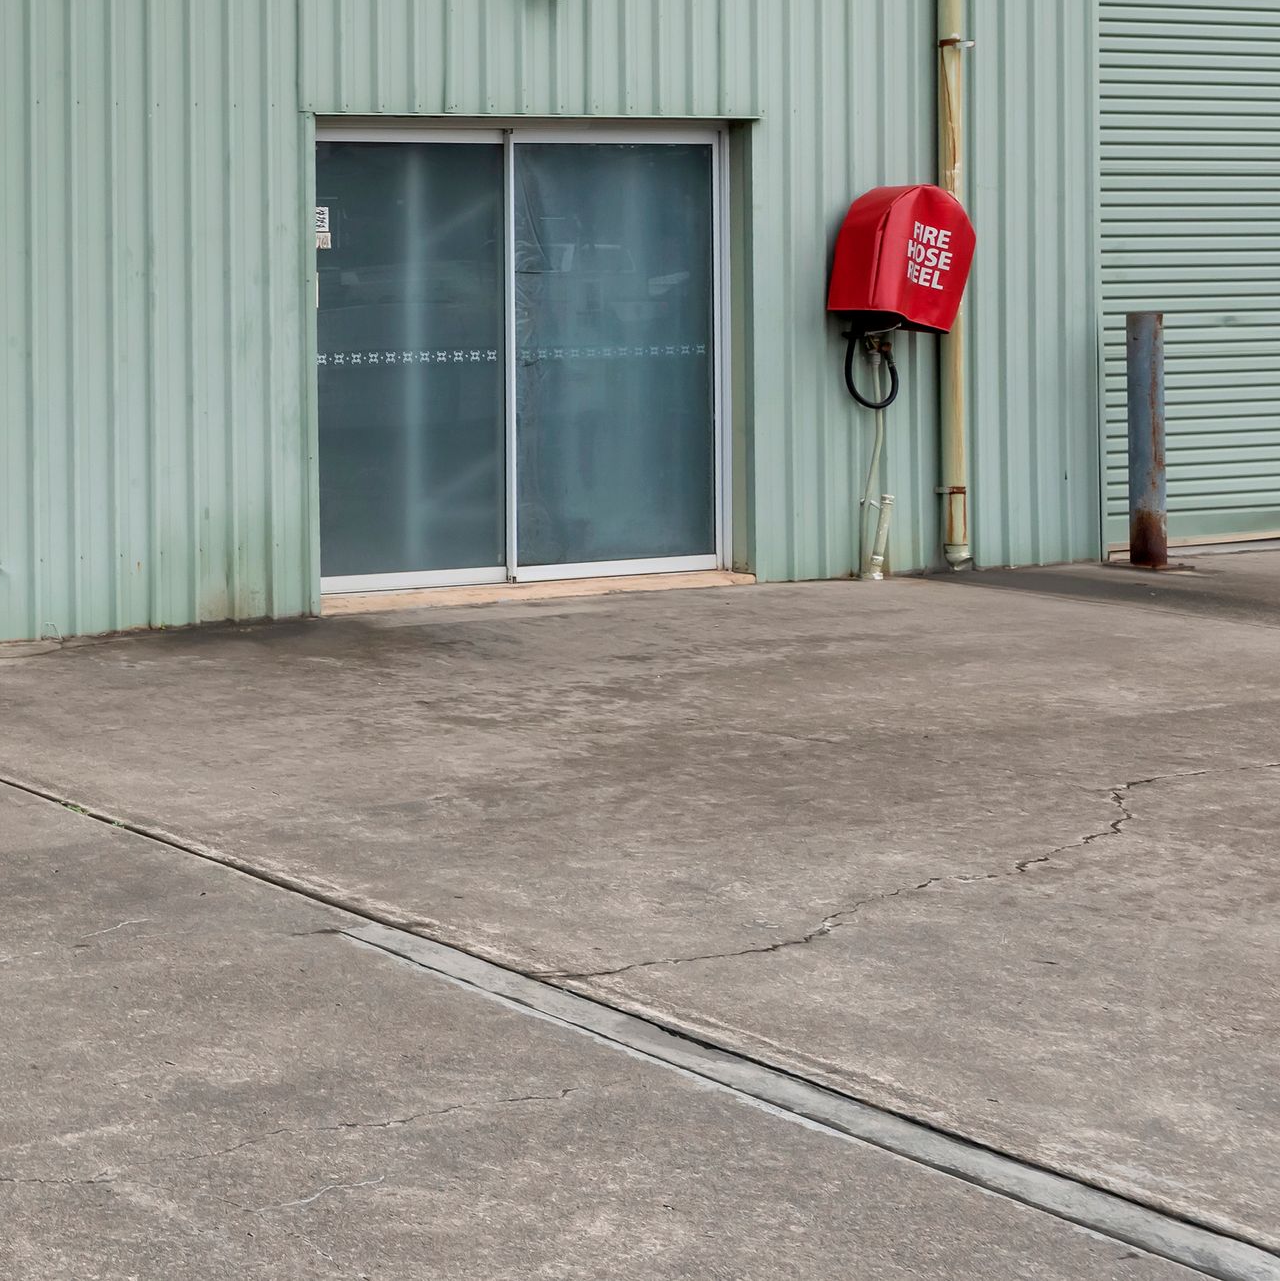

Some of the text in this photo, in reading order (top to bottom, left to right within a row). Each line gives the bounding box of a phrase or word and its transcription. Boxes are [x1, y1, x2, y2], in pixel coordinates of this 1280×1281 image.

[913, 220, 952, 249] FIRE
[907, 239, 953, 271] HOSE
[907, 260, 944, 290] REEL
